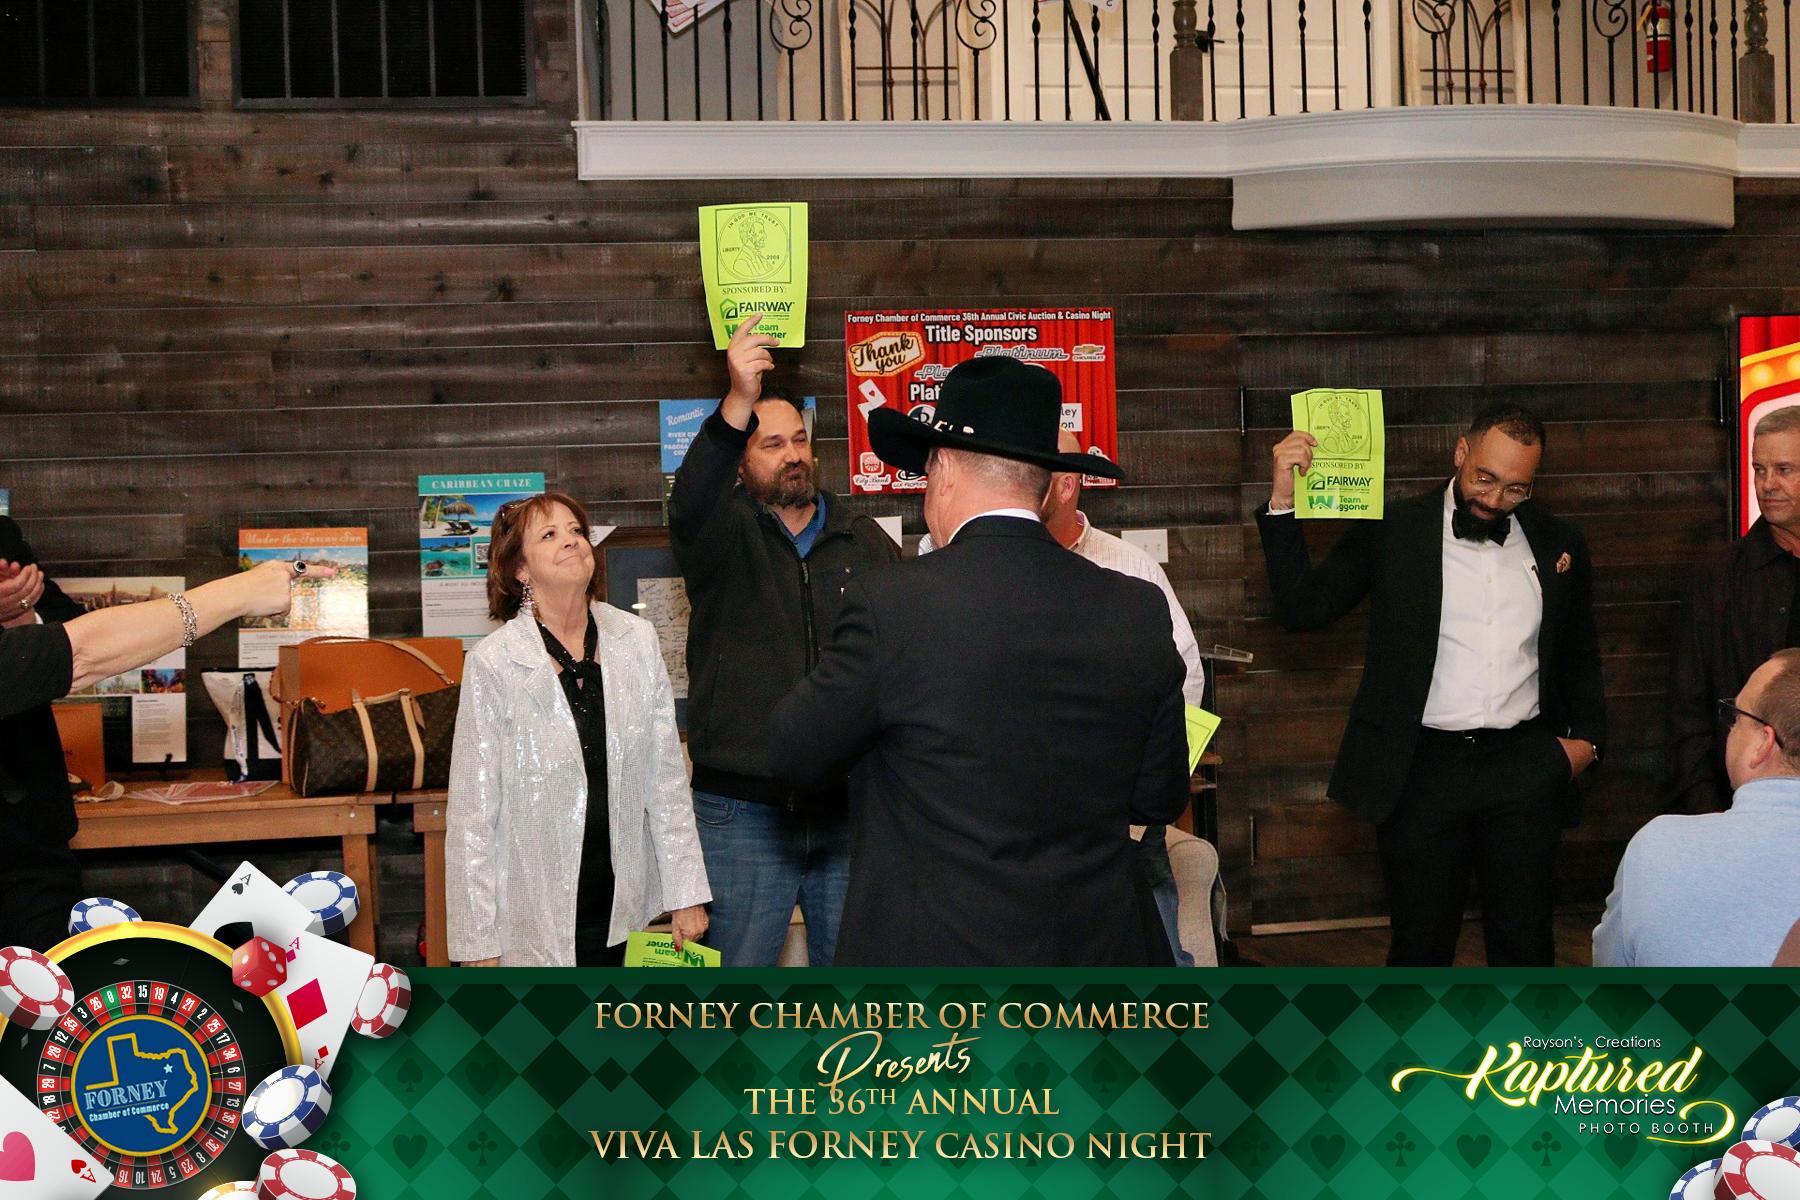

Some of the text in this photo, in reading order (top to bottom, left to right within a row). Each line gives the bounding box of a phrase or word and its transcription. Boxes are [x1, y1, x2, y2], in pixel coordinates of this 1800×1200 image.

[722, 286, 772, 295] SPONSORED
[739, 301, 793, 312] FAIRWAY
[847, 311, 1111, 324] Forney Chamber of Commerce 36th Annual Civic Auction & Casino Night
[925, 325, 1038, 345] Title Sponsors
[850, 333, 914, 367] Thank
[875, 353, 906, 375] you
[910, 384, 943, 401] Plat
[432, 479, 532, 489] CARIBBEAN CRAZE
[1327, 476, 1371, 486] FAIRWAY
[1339, 495, 1361, 503] Team
